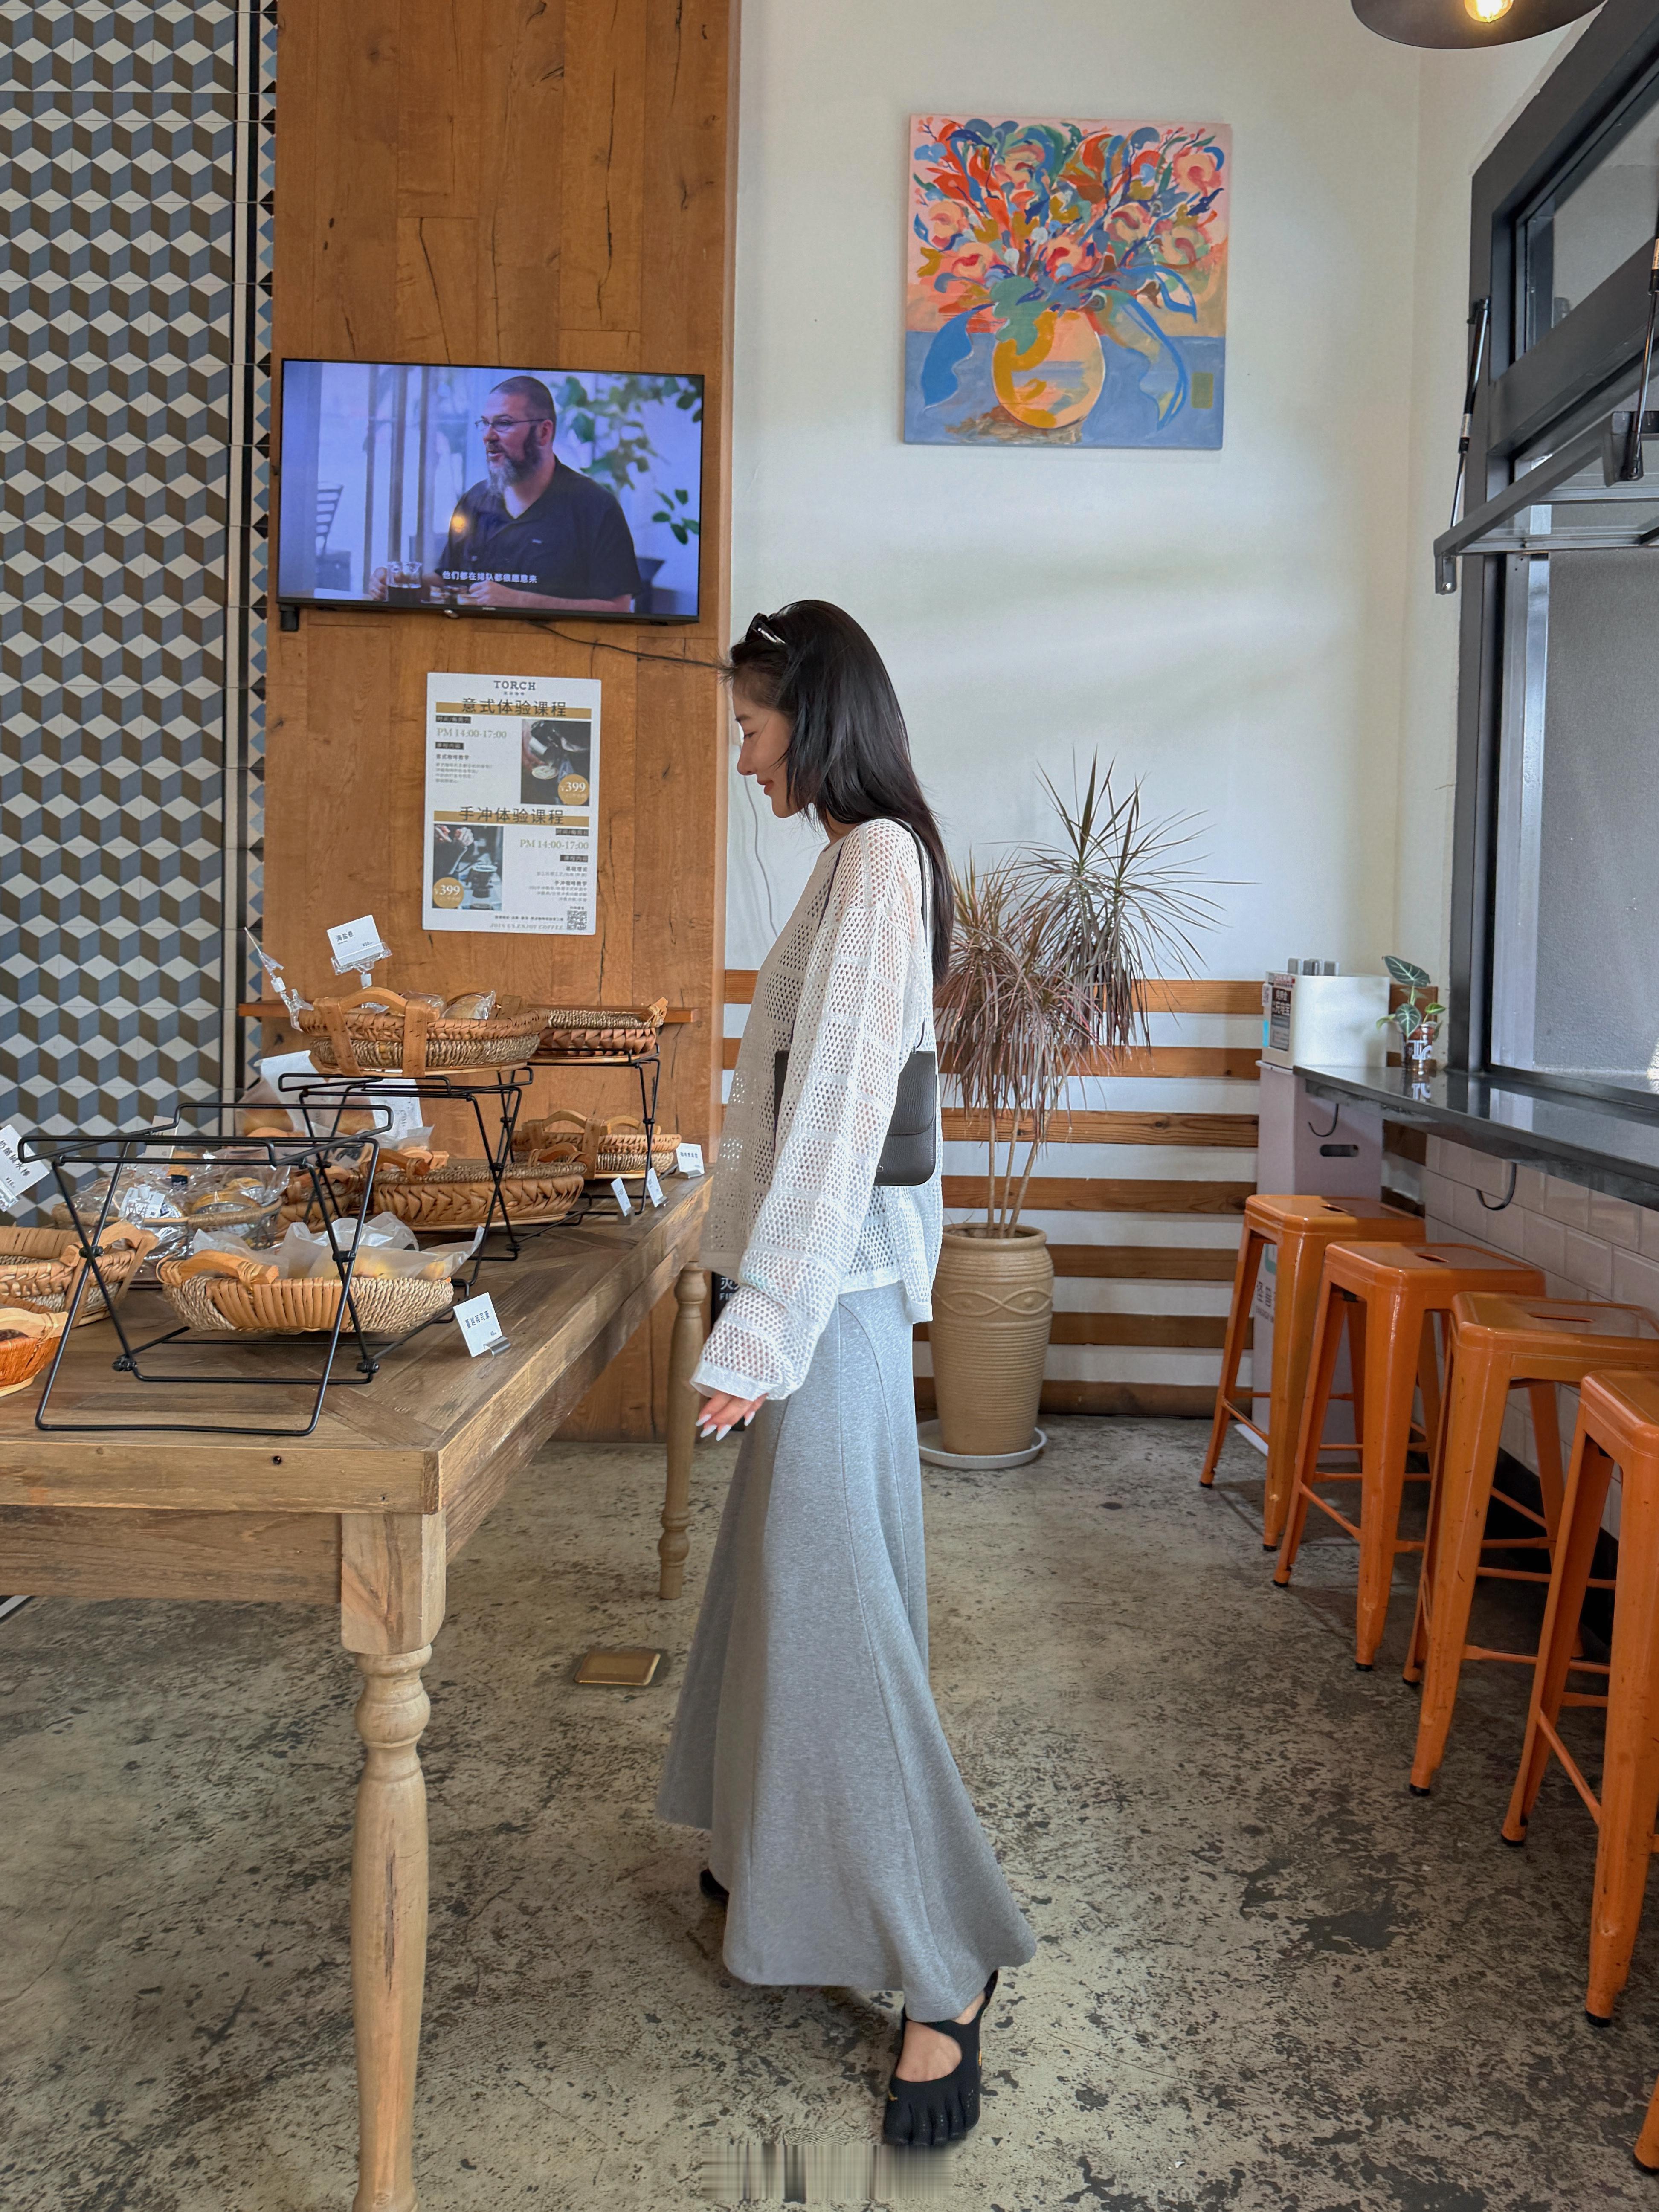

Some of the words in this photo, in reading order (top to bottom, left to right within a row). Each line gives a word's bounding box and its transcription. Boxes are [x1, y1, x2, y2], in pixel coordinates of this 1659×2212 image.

[493, 680, 536, 690] TORCH
[462, 698, 566, 717] 意式体验课程
[437, 728, 452, 736] PM
[455, 730, 507, 739] 14:00-17:00
[459, 806, 564, 825] 手冲体验课程
[520, 839, 535, 848] PM
[538, 841, 589, 849] 14:00-17:00
